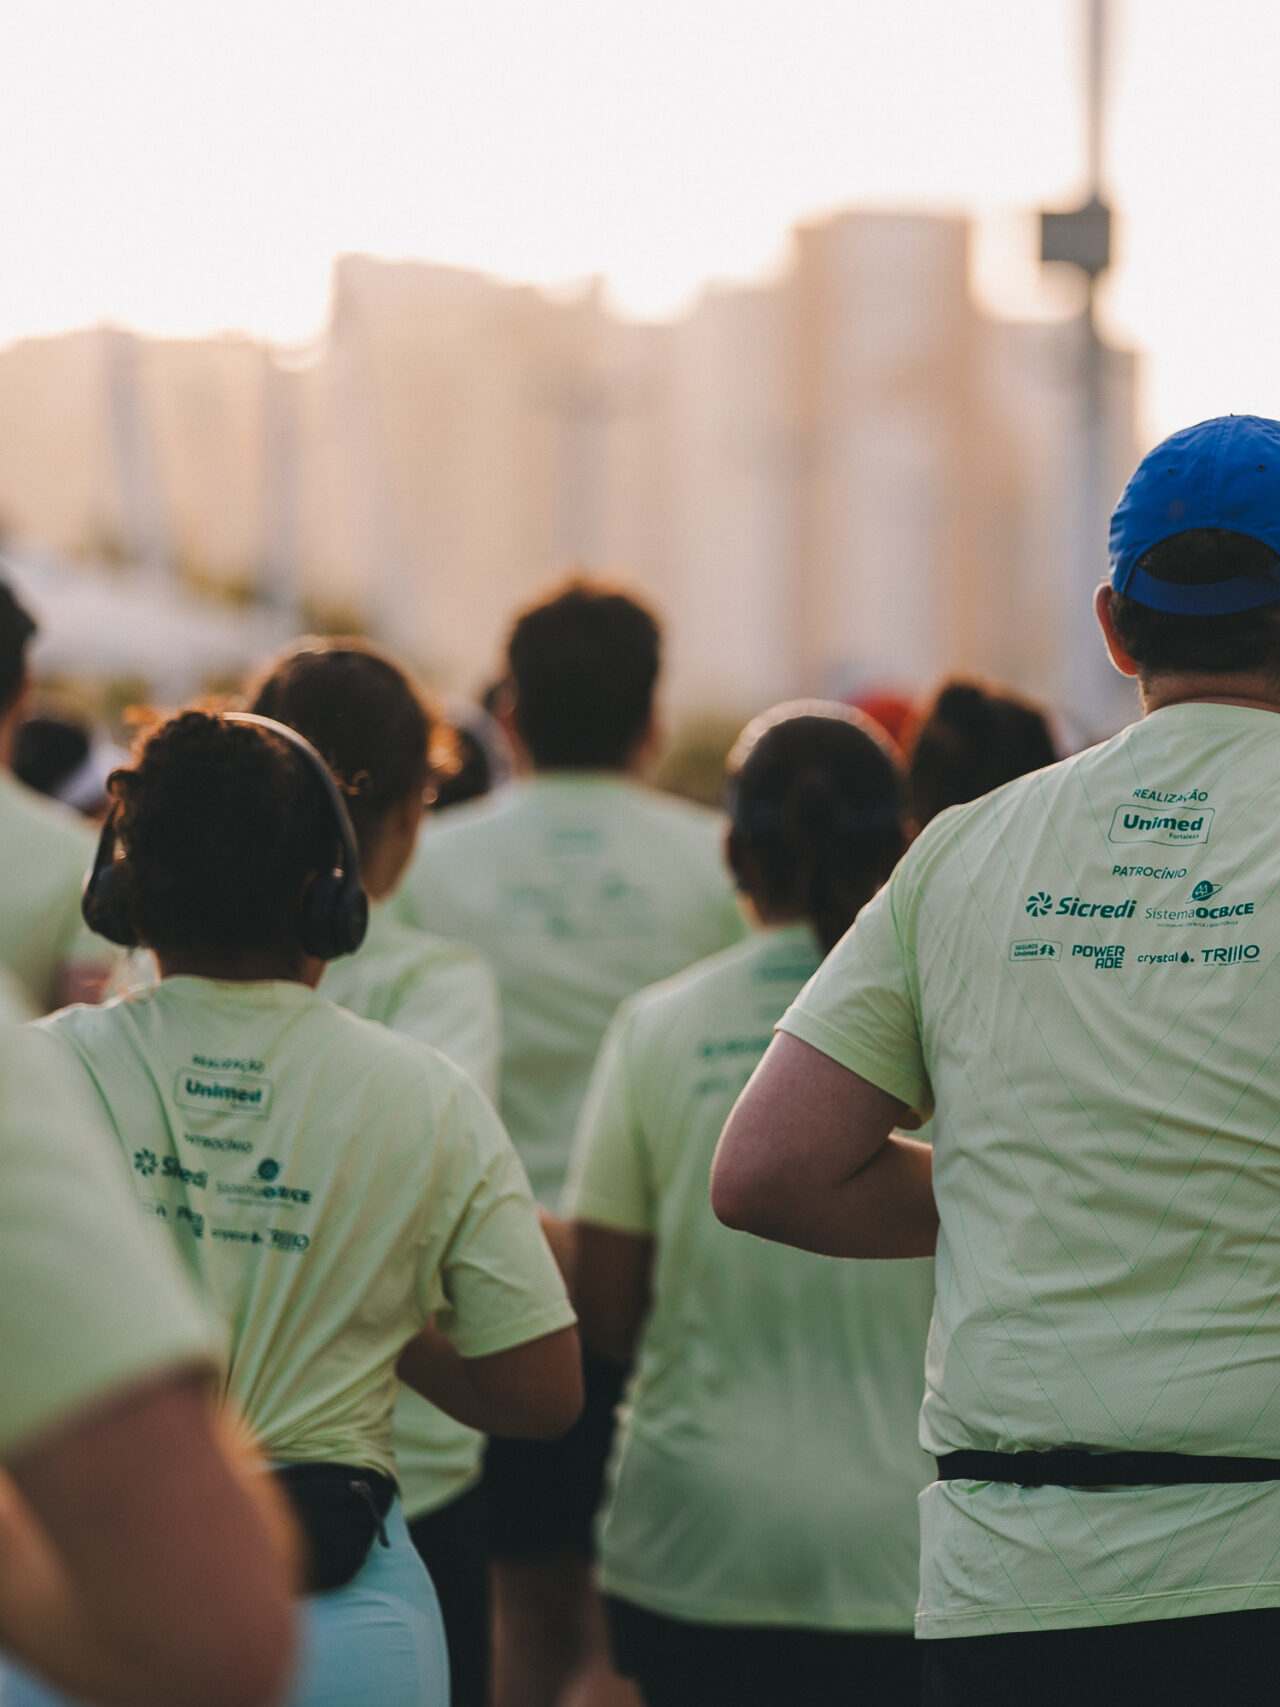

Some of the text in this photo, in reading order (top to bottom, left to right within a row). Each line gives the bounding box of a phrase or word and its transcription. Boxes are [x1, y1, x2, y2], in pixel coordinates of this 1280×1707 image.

[1123, 814, 1204, 831] Unimed
[1112, 865, 1187, 880] PATROCÍNIO
[1055, 897, 1137, 919] Sicredi
[1072, 945, 1125, 957] POWER
[1137, 952, 1178, 964] crystal
[1094, 957, 1122, 969] ADE
[186, 1078, 262, 1103] Unimed
